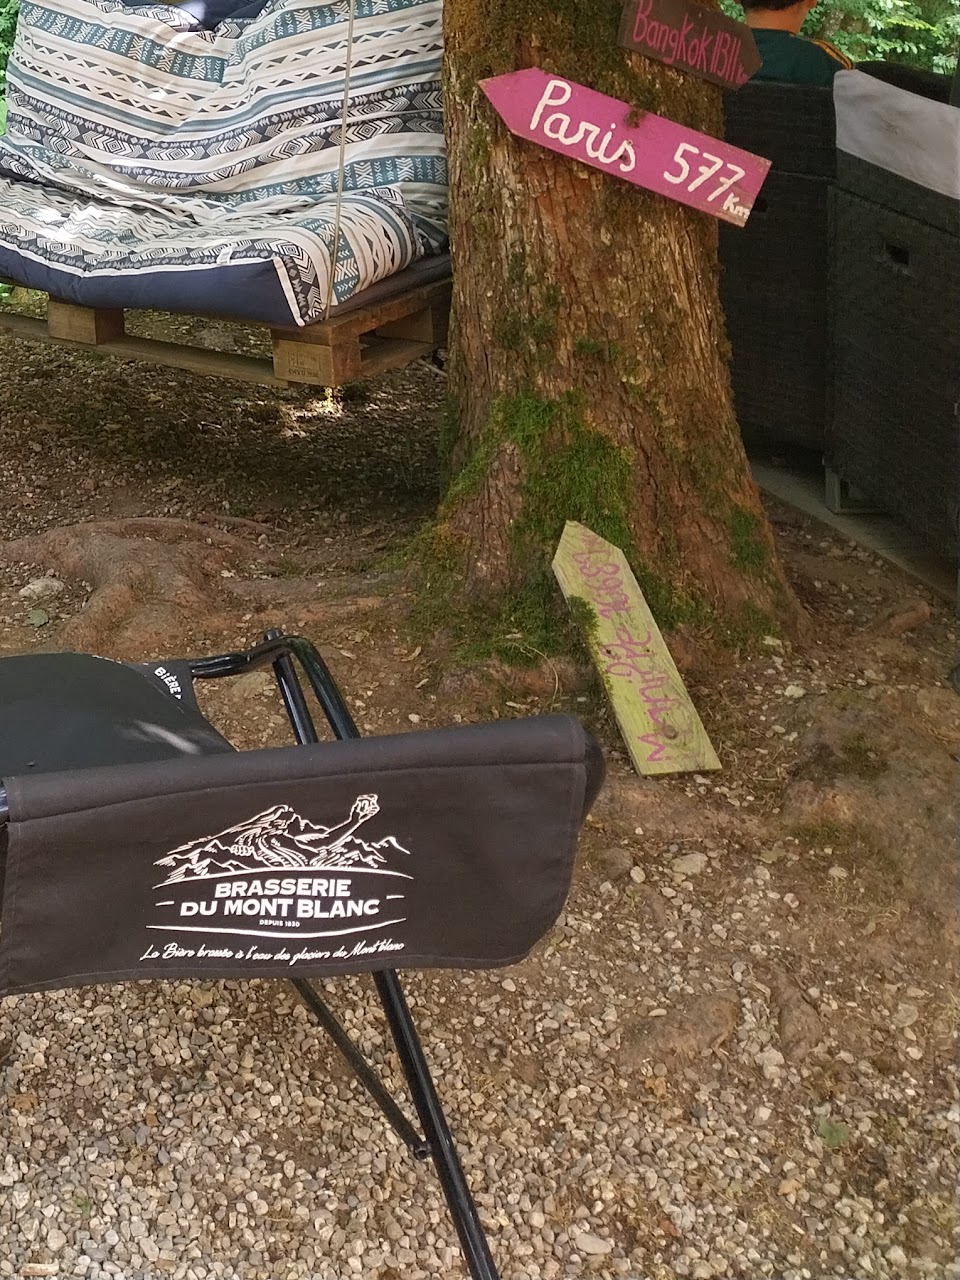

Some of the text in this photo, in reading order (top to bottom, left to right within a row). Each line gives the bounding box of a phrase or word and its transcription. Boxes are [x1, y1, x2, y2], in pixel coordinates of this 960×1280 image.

[529, 80, 636, 172] Paris
[663, 142, 746, 202] 577
[214, 878, 352, 899] BRASSERIE
[180, 899, 380, 919] DU MONT BLANC
[259, 919, 284, 927] DEPUIS
[140, 944, 160, 961] La
[162, 942, 196, 959] Bière
[274, 948, 291, 960] des
[289, 947, 330, 966] glaciers
[344, 940, 380, 959] Mont
